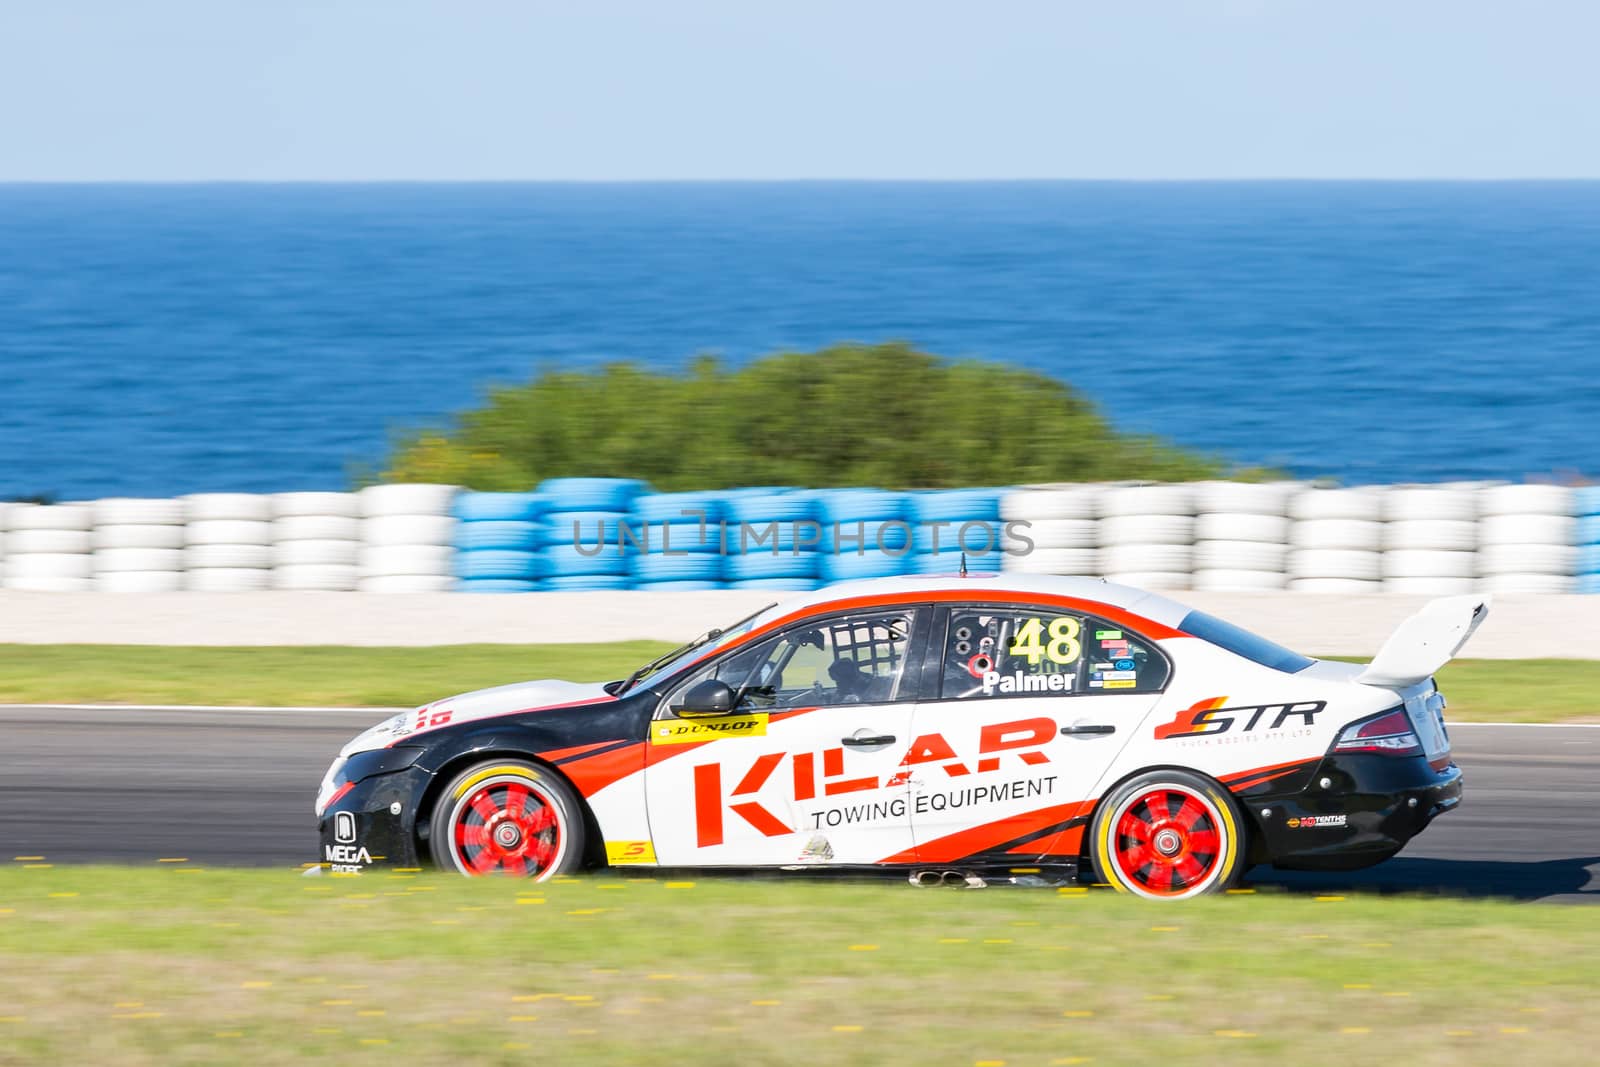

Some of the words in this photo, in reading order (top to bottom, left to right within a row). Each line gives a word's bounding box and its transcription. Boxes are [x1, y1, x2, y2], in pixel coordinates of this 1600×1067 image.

[1009, 616, 1081, 665] 48
[982, 670, 1076, 695] Palmer
[676, 721, 759, 735] DUNLOP
[1165, 700, 1328, 739] STR
[694, 717, 1057, 848] KILAR
[811, 799, 906, 830] TOWING
[915, 775, 1058, 814] EQUIPMENT
[325, 844, 373, 864] MEGA
